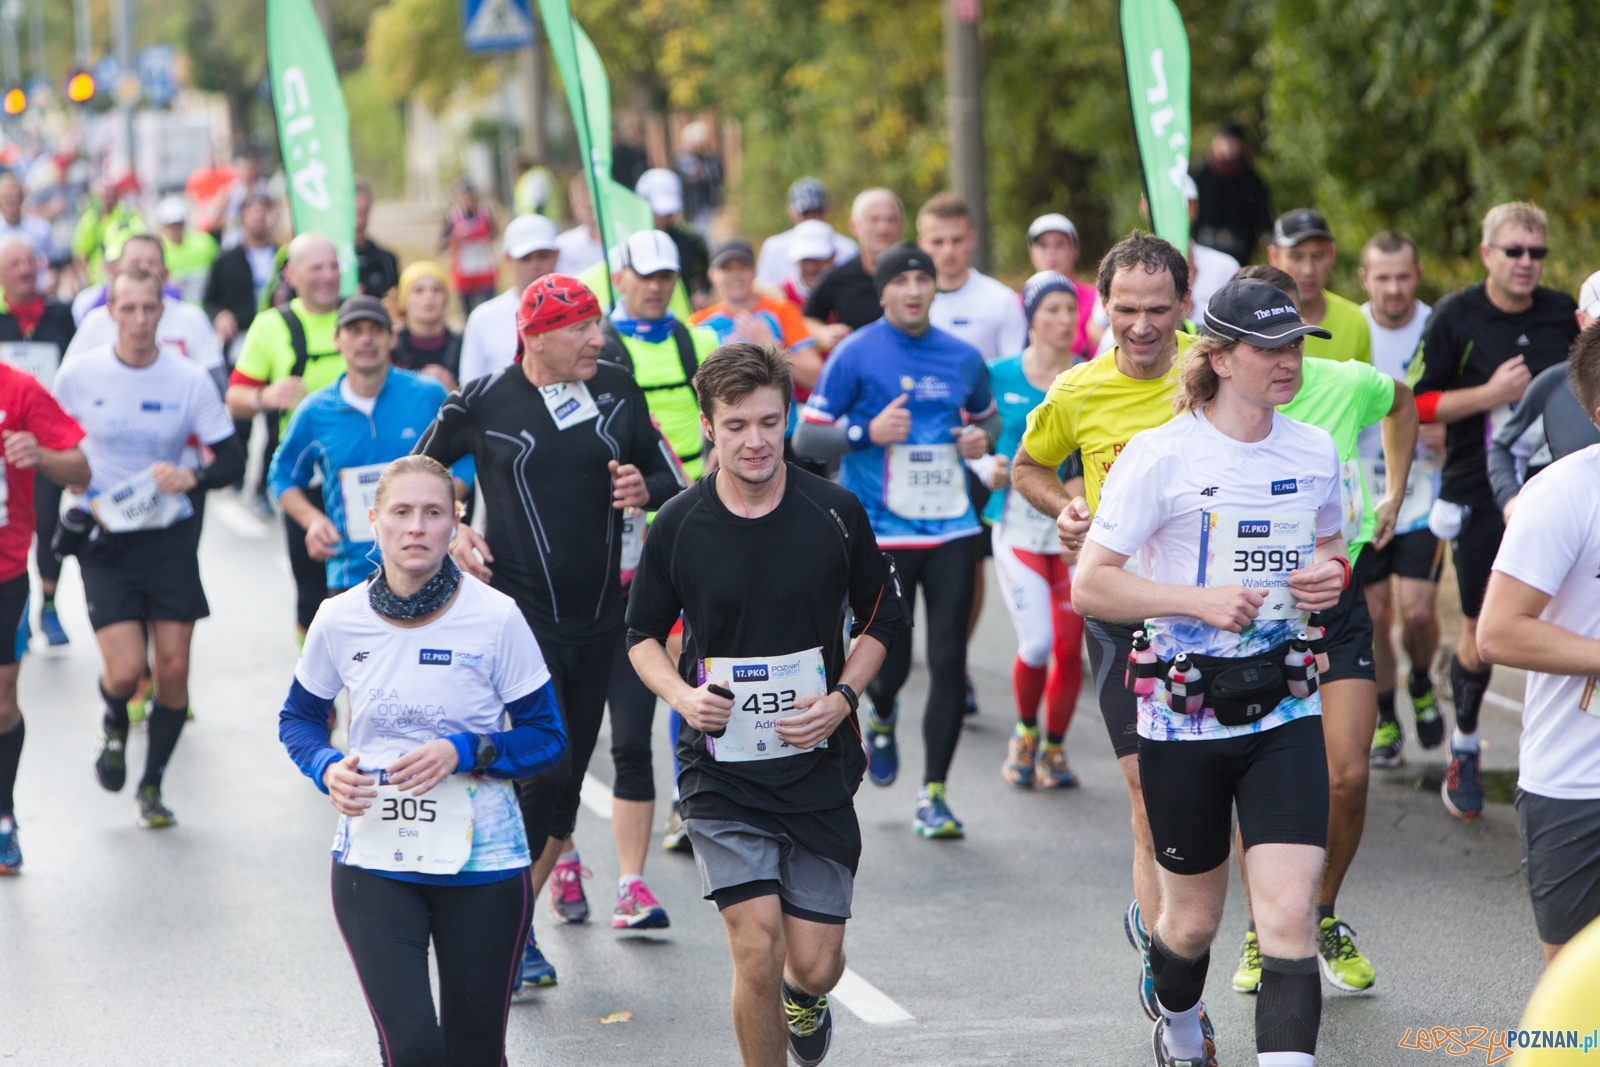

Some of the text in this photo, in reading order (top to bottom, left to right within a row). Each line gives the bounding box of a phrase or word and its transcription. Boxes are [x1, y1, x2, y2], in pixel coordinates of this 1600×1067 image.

[1253, 310, 1271, 320] The
[908, 468, 953, 486] 3392
[1200, 486, 1219, 497] 4F
[1241, 524, 1268, 533] 17.PKO
[1233, 550, 1300, 572] 3999
[1242, 579, 1289, 588] Waldema
[352, 651, 370, 662] 4F
[422, 653, 450, 661] 17.PKO
[736, 668, 766, 678] 17.PKO
[369, 688, 399, 701] SIŁA
[741, 689, 797, 715] 433
[378, 703, 446, 717] ODWAGA
[754, 719, 778, 730] Adri
[381, 798, 437, 822] 305
[399, 828, 419, 838] Ewa
